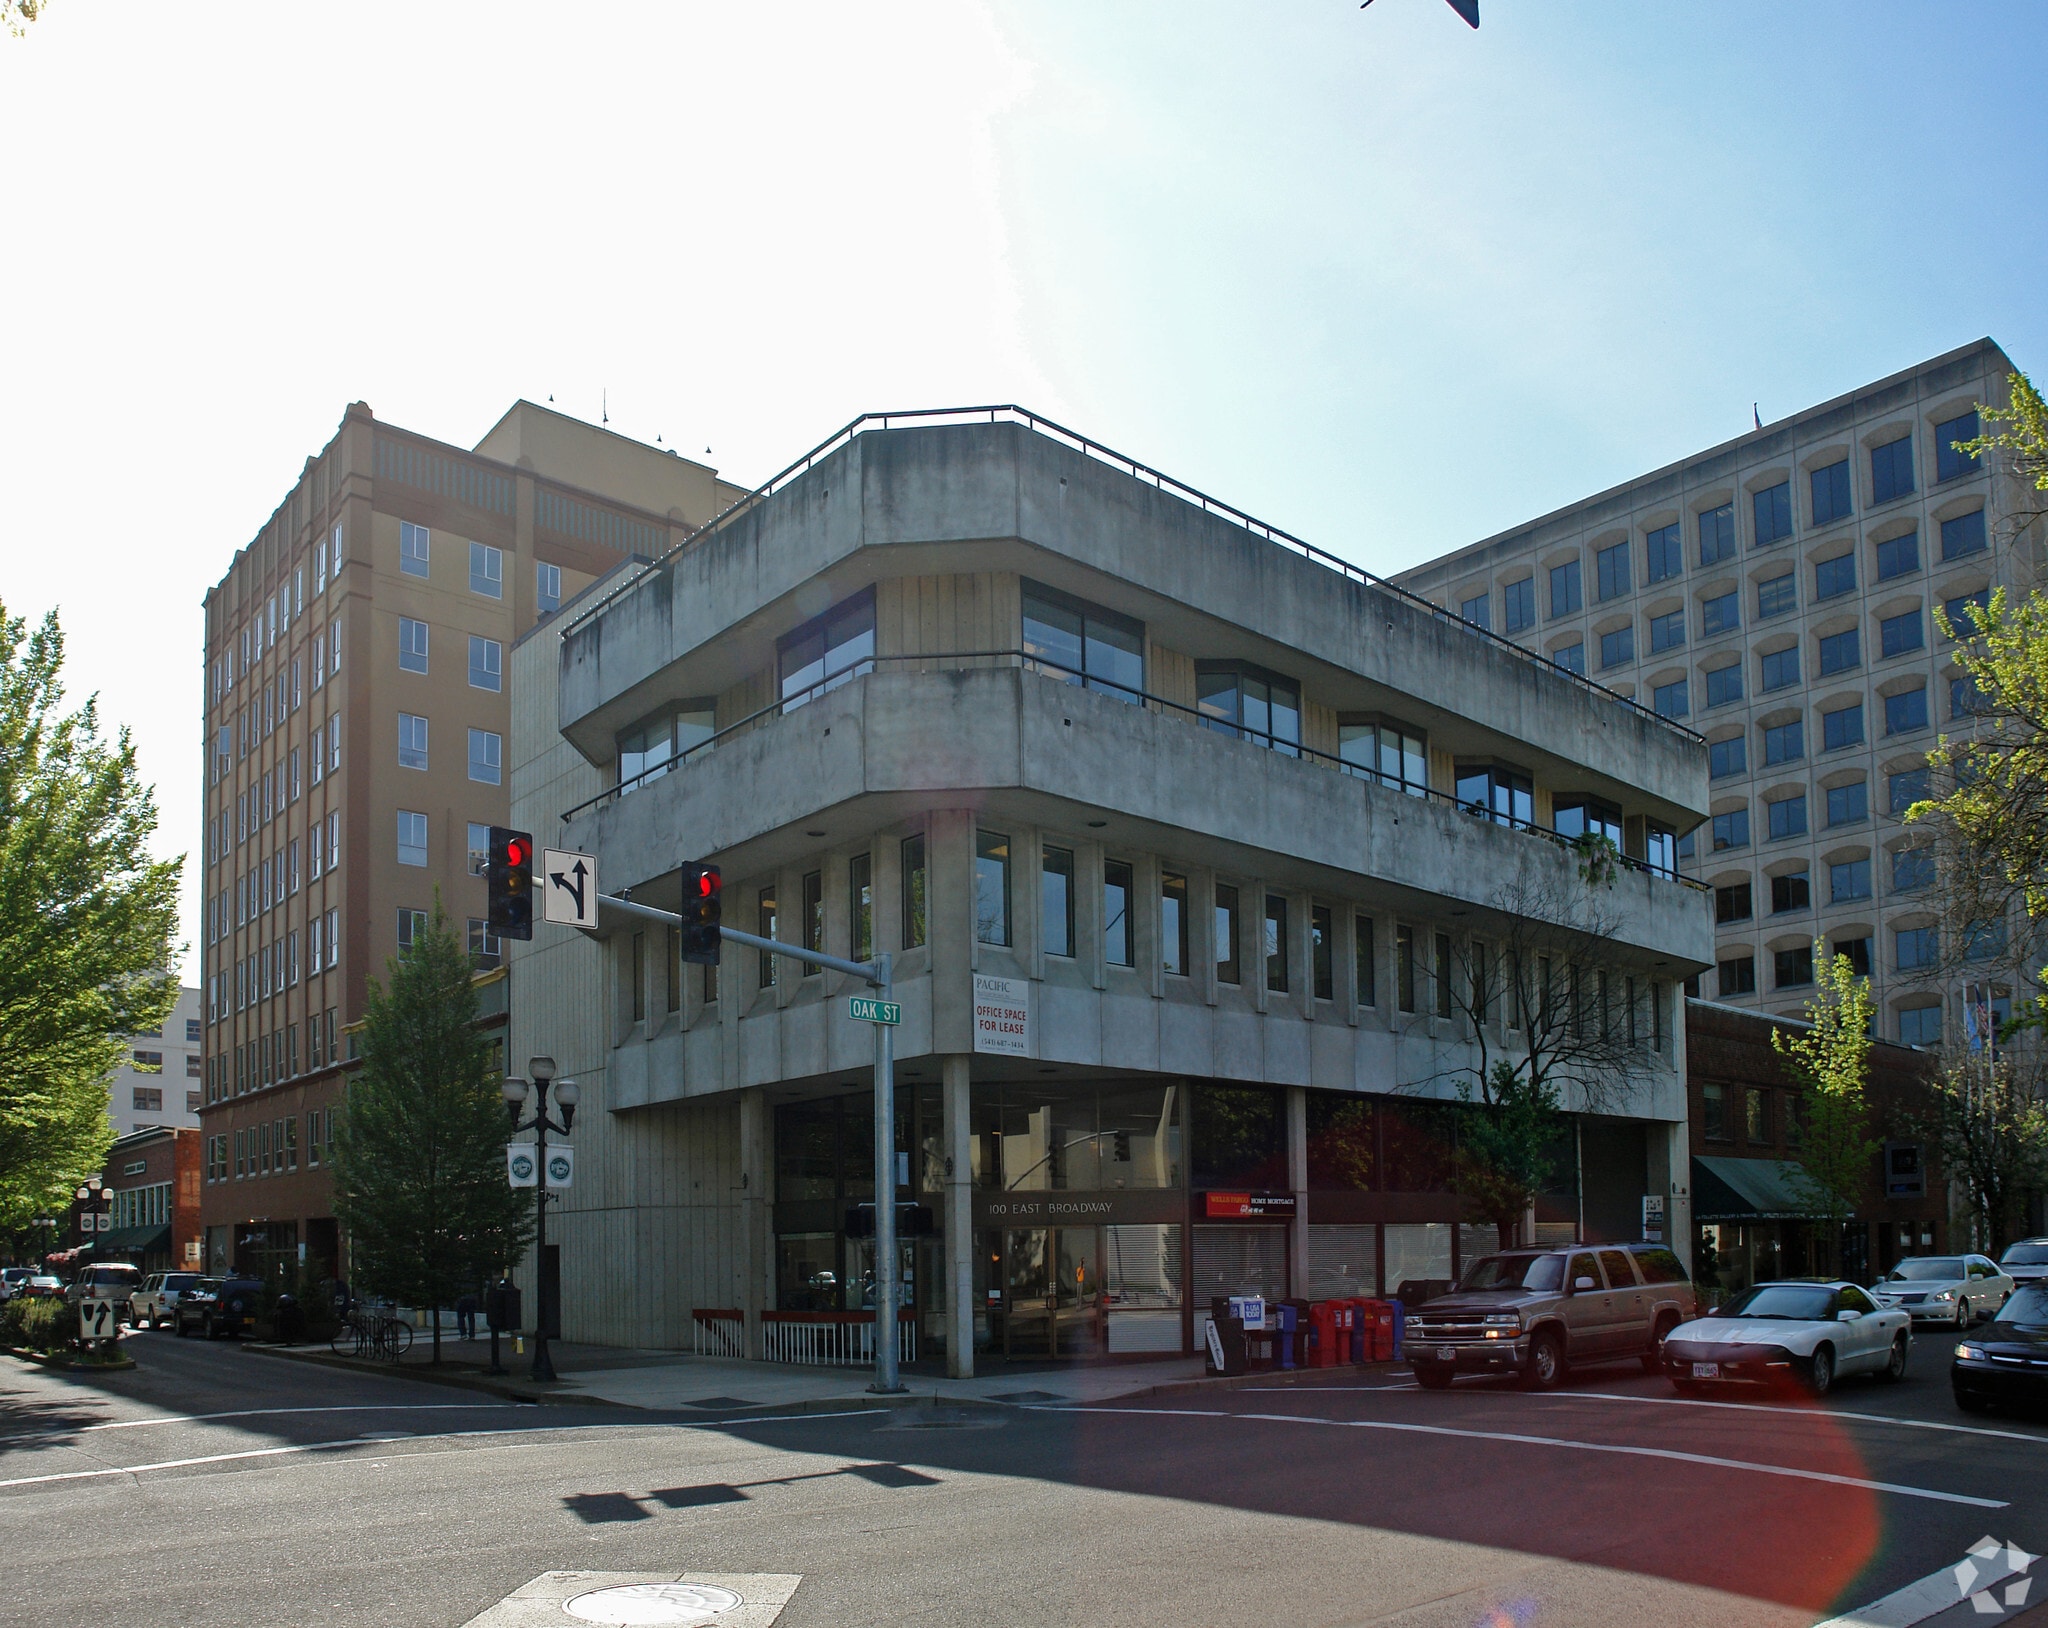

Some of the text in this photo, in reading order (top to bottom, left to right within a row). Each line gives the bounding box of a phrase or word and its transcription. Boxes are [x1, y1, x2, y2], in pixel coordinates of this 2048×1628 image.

[976, 978, 1011, 993] PACIFIC
[853, 1000, 898, 1021] OAK ST
[976, 1005, 1026, 1021] OFFICE SPACE
[979, 1019, 1024, 1034] FOR LEASE
[1210, 1196, 1230, 1204] WELLS
[1250, 1197, 1266, 1205] HOME
[989, 1202, 1113, 1215] 100 EAST BROADWAY
[1249, 1304, 1260, 1312] USA
